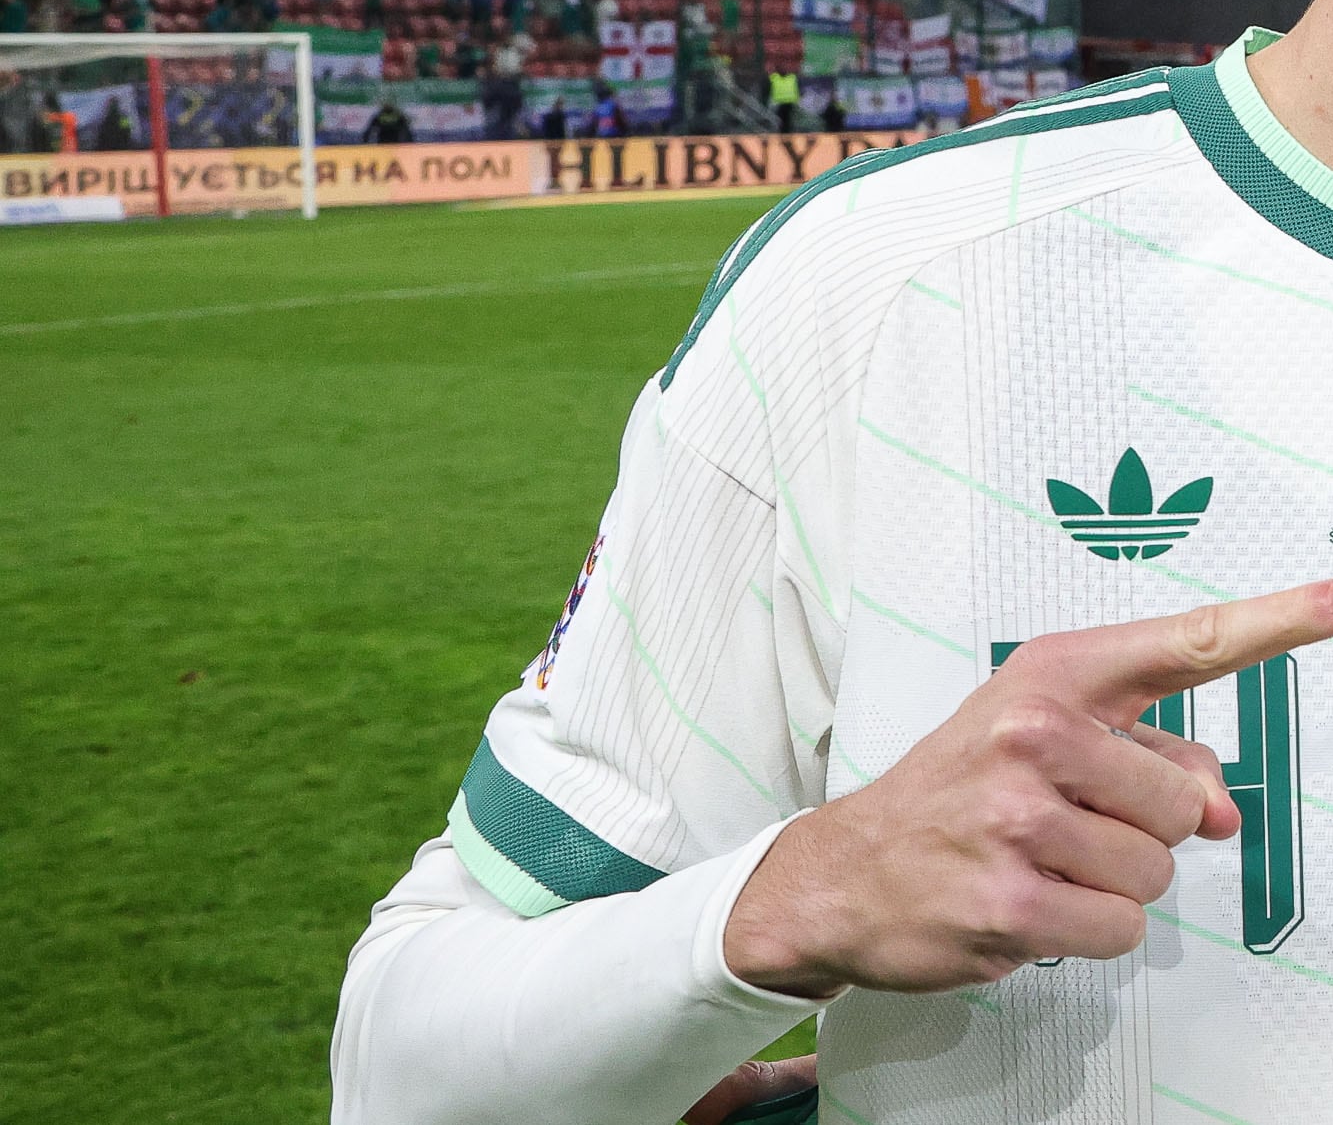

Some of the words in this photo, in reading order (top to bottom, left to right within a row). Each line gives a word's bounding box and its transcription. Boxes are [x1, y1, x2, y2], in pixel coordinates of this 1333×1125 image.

[353, 159, 408, 184] НА
[421, 154, 512, 181] ПОЛІ
[547, 136, 817, 192] HLIBNY
